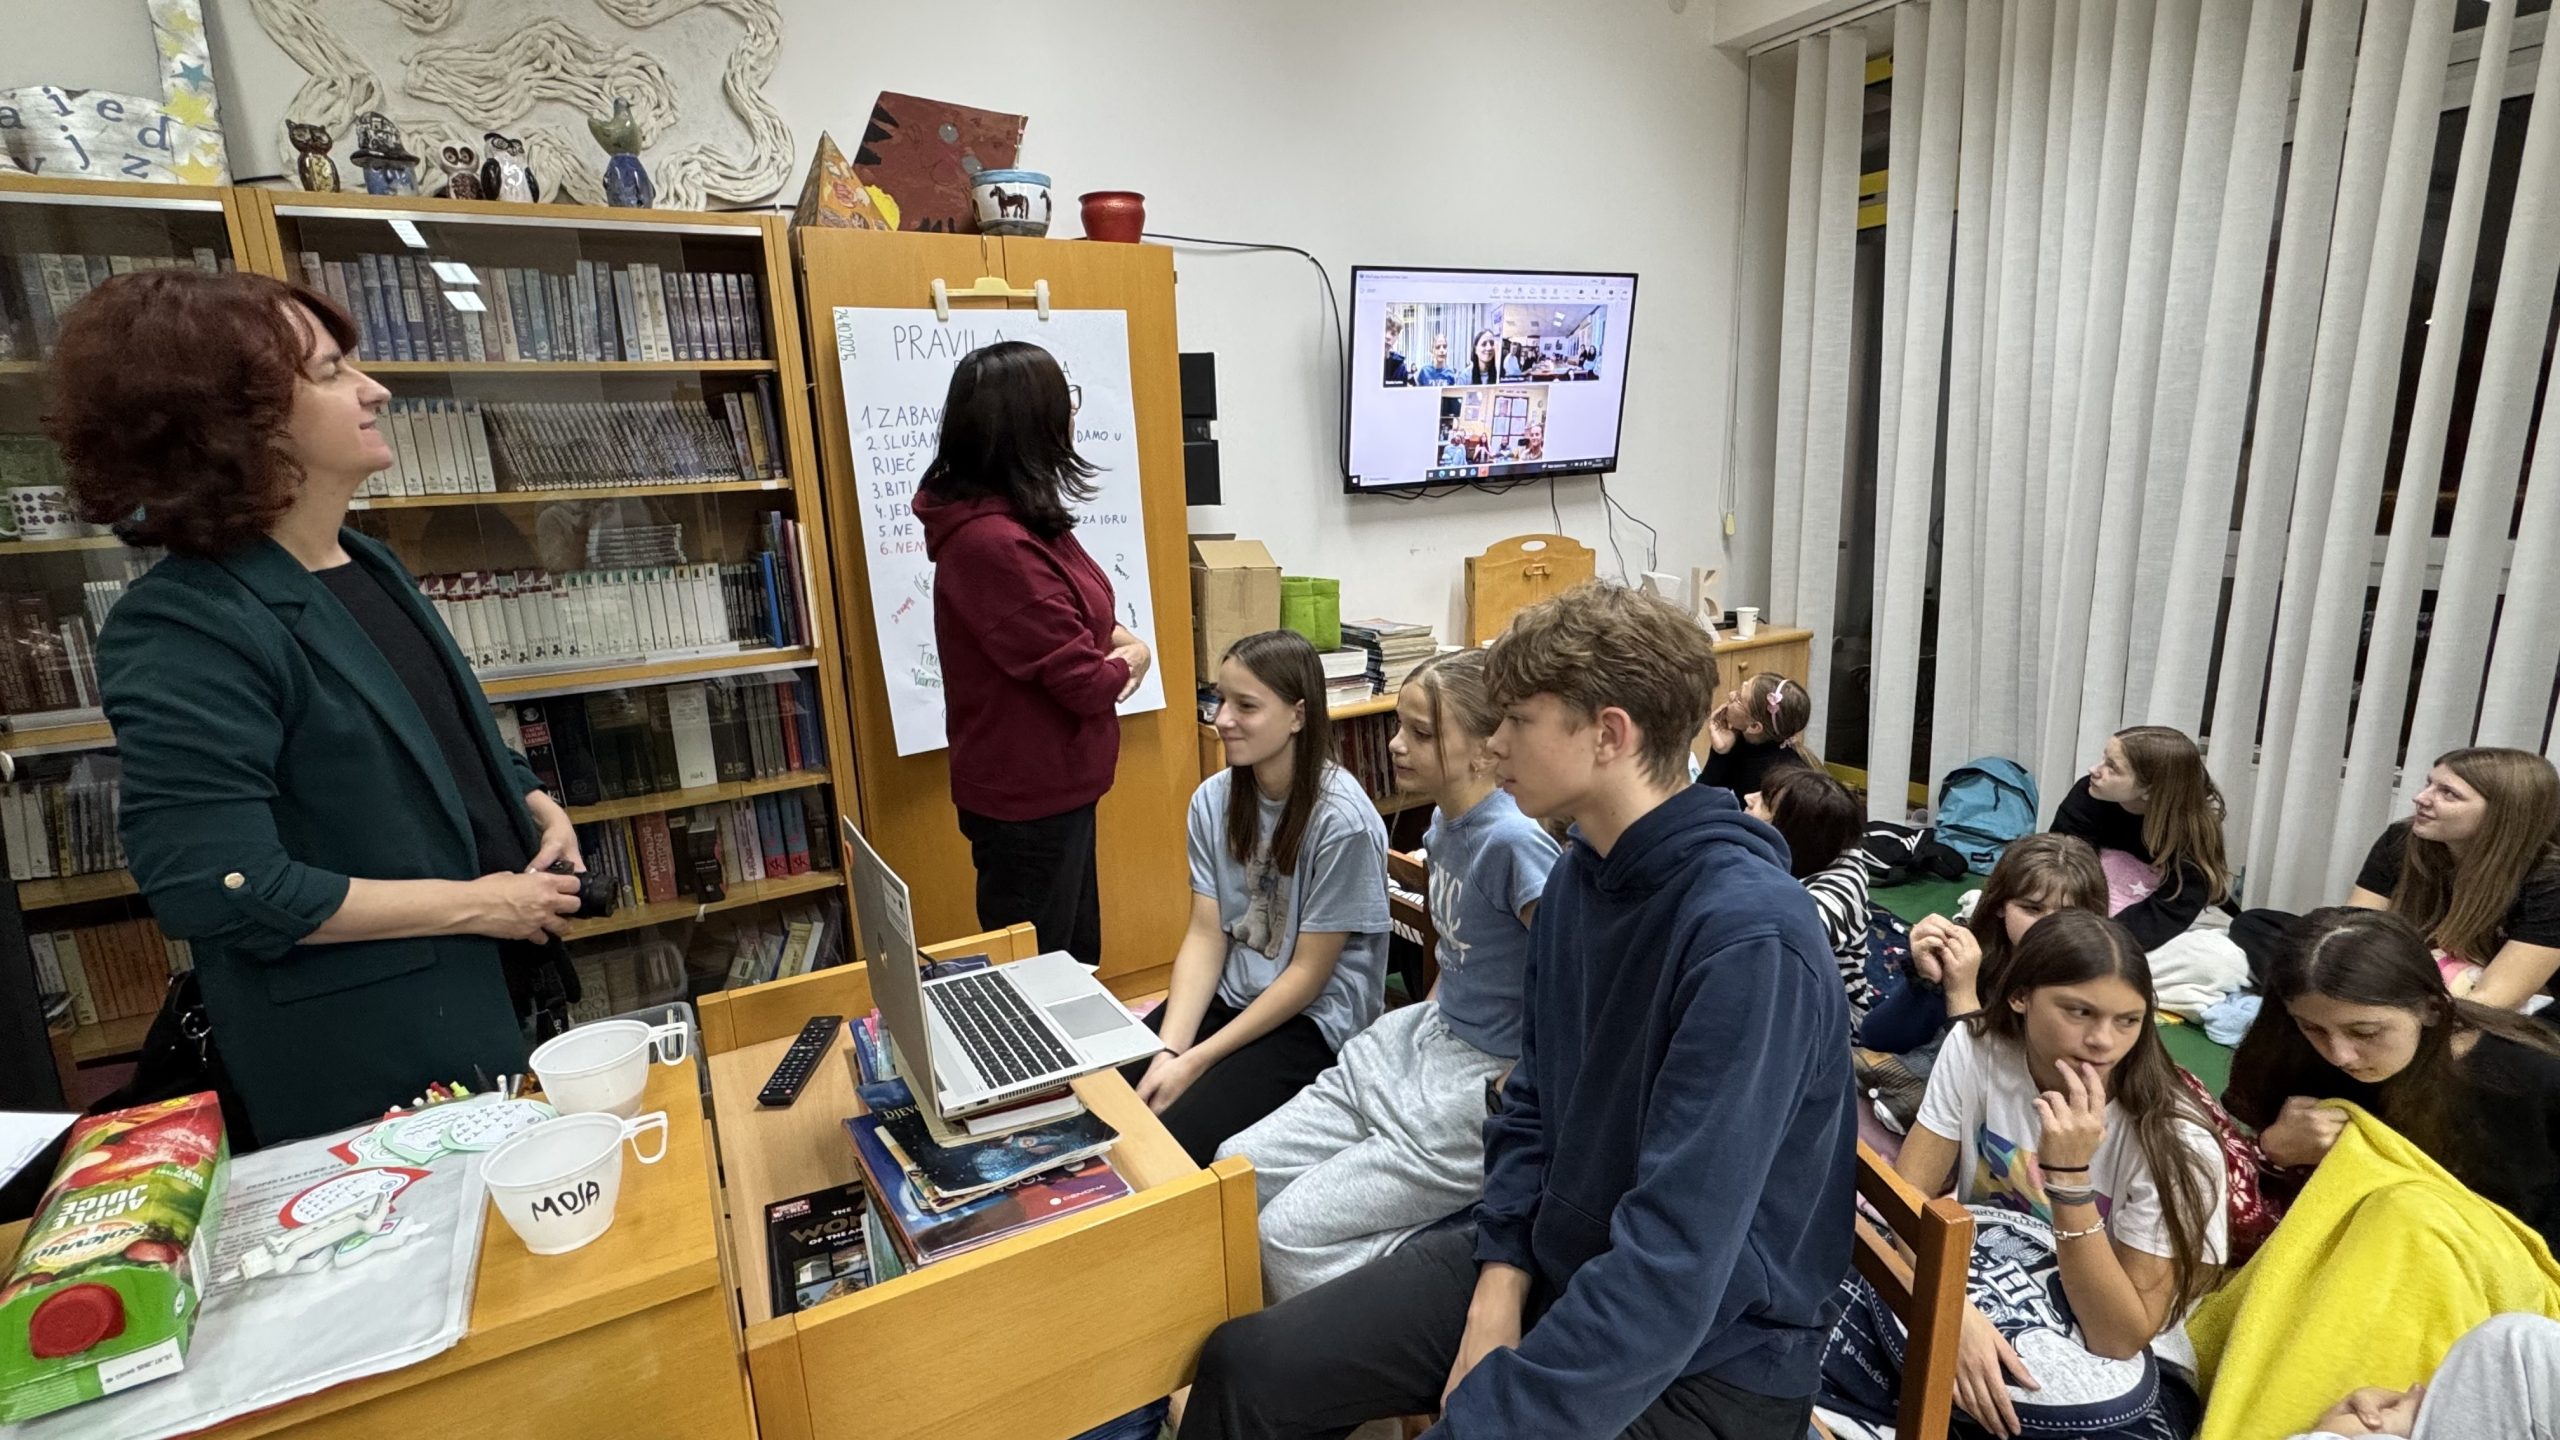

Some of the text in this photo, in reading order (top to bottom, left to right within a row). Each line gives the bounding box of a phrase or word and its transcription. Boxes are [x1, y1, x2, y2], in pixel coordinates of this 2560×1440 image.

[877, 406, 941, 429] ZABAV
[1073, 430, 1108, 442] DAMO
[872, 452, 916, 476] RIJEČ
[885, 480, 912, 497] BITI
[888, 503, 912, 521] JED
[61, 1184, 149, 1215] JUICE
[531, 1180, 600, 1222] MOJA
[50, 1195, 148, 1231] APPLE
[831, 1207, 852, 1216] THE
